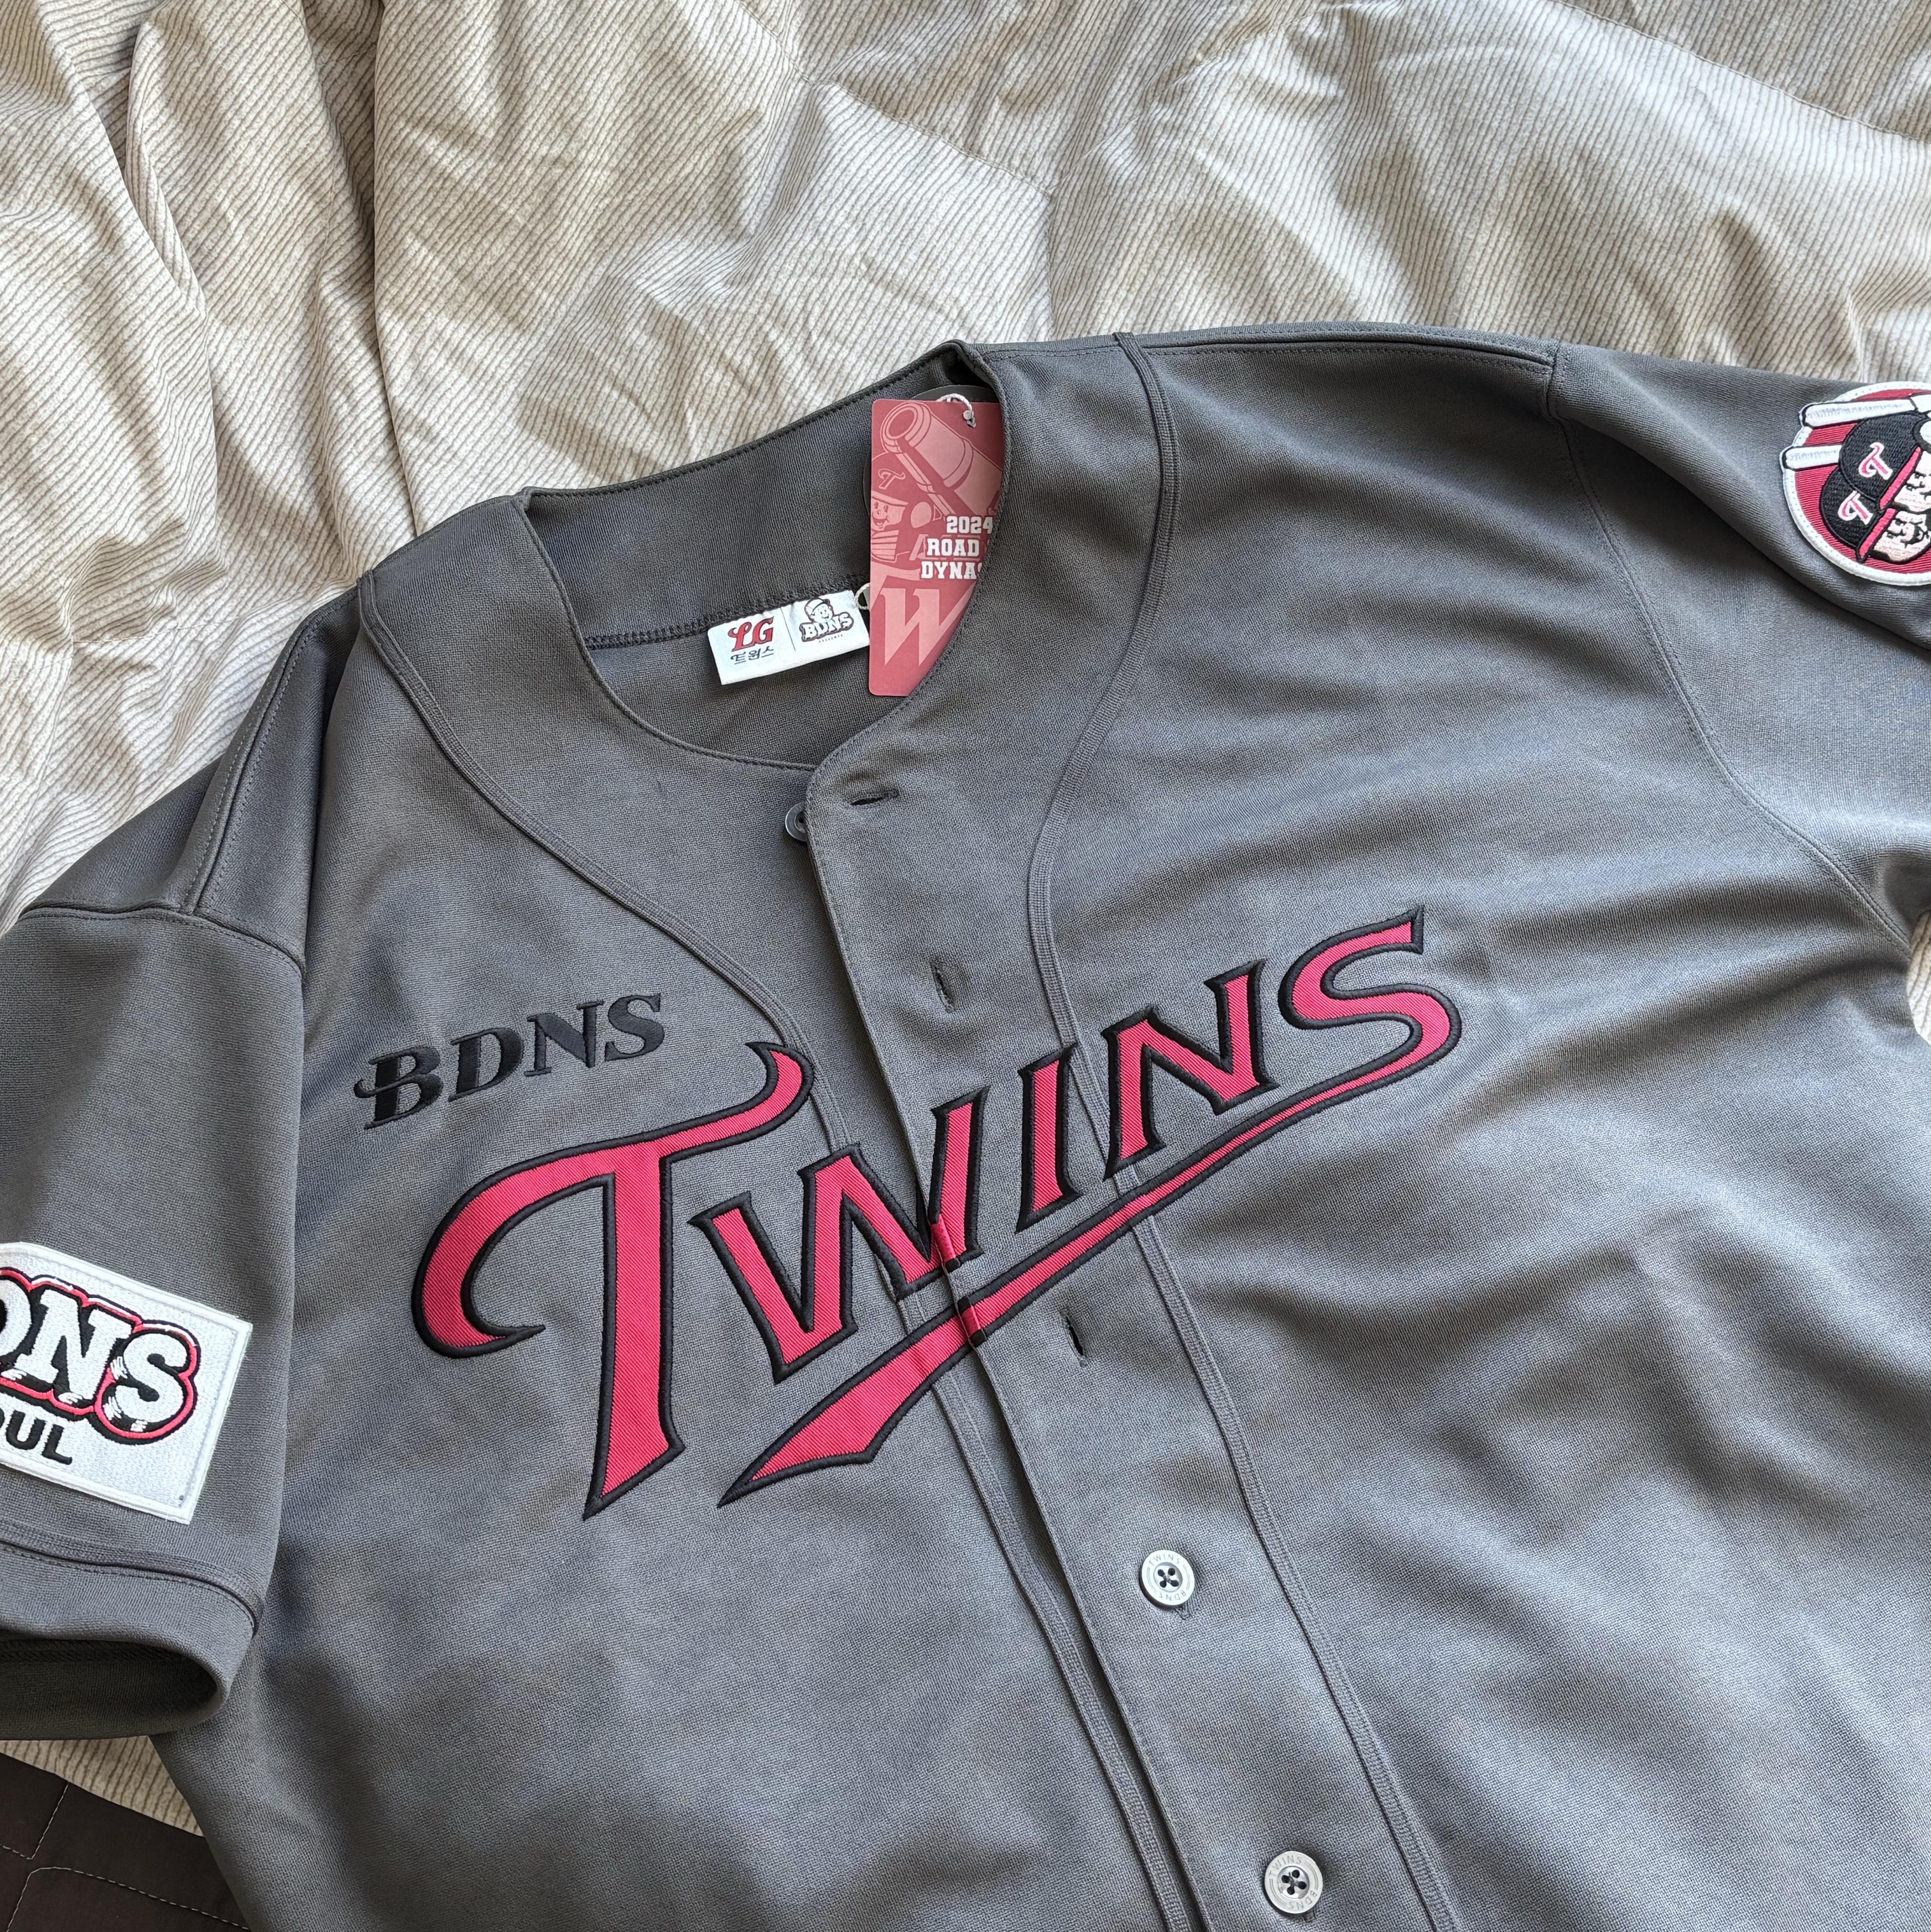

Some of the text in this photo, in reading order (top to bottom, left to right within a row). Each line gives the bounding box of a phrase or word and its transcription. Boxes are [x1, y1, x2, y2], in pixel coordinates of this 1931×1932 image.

[947, 516, 993, 534] 2024
[927, 538, 979, 557] ROAD
[728, 616, 774, 652] LG
[353, 992, 665, 1129] BDNS
[411, 907, 1462, 1520] TWINS
[0, 1408, 73, 1465] UL
[1148, 1554, 1180, 1566] TWINS
[1269, 1855, 1302, 1877] TWINS
[1288, 1890, 1317, 1910] BDNS
